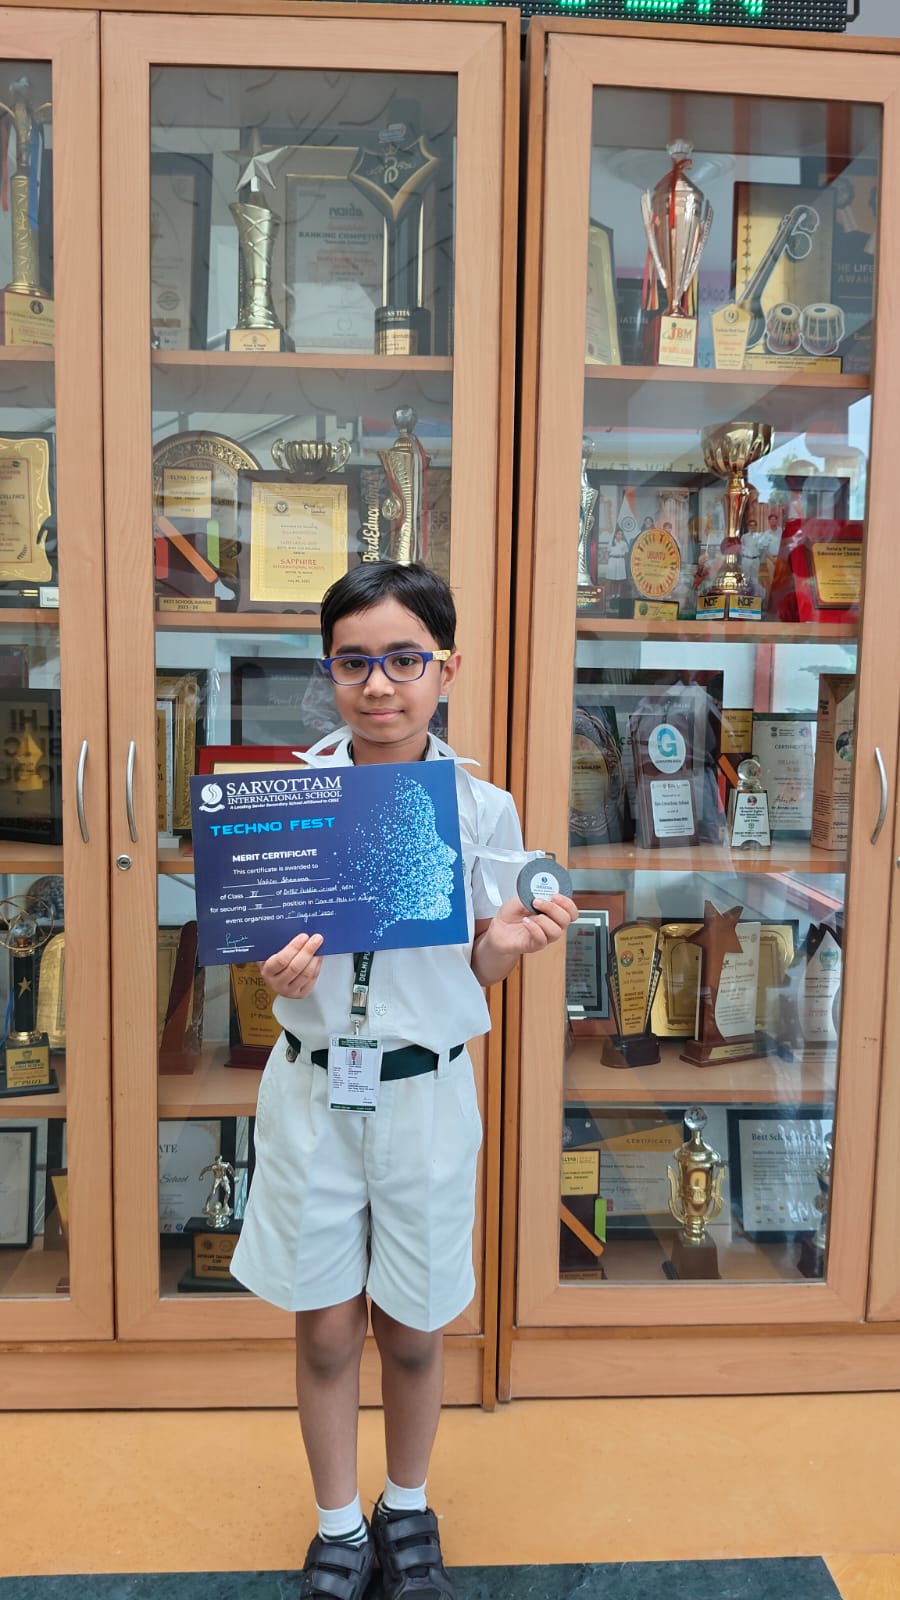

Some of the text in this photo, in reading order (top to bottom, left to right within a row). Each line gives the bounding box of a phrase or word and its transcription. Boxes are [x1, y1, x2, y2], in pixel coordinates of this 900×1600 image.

[226, 776, 342, 796] SARVOTTAM
[228, 790, 342, 805] INTERNATIONAL SCHOOL
[210, 817, 336, 838] TECHNO FEST
[232, 849, 318, 863] MERIT CERTIFICATE
[246, 866, 278, 874] certificate
[284, 863, 311, 871] awarded
[219, 905, 247, 913] securing
[282, 900, 307, 908] position
[243, 915, 275, 923] organized
[752, 1133, 768, 1141] Best
